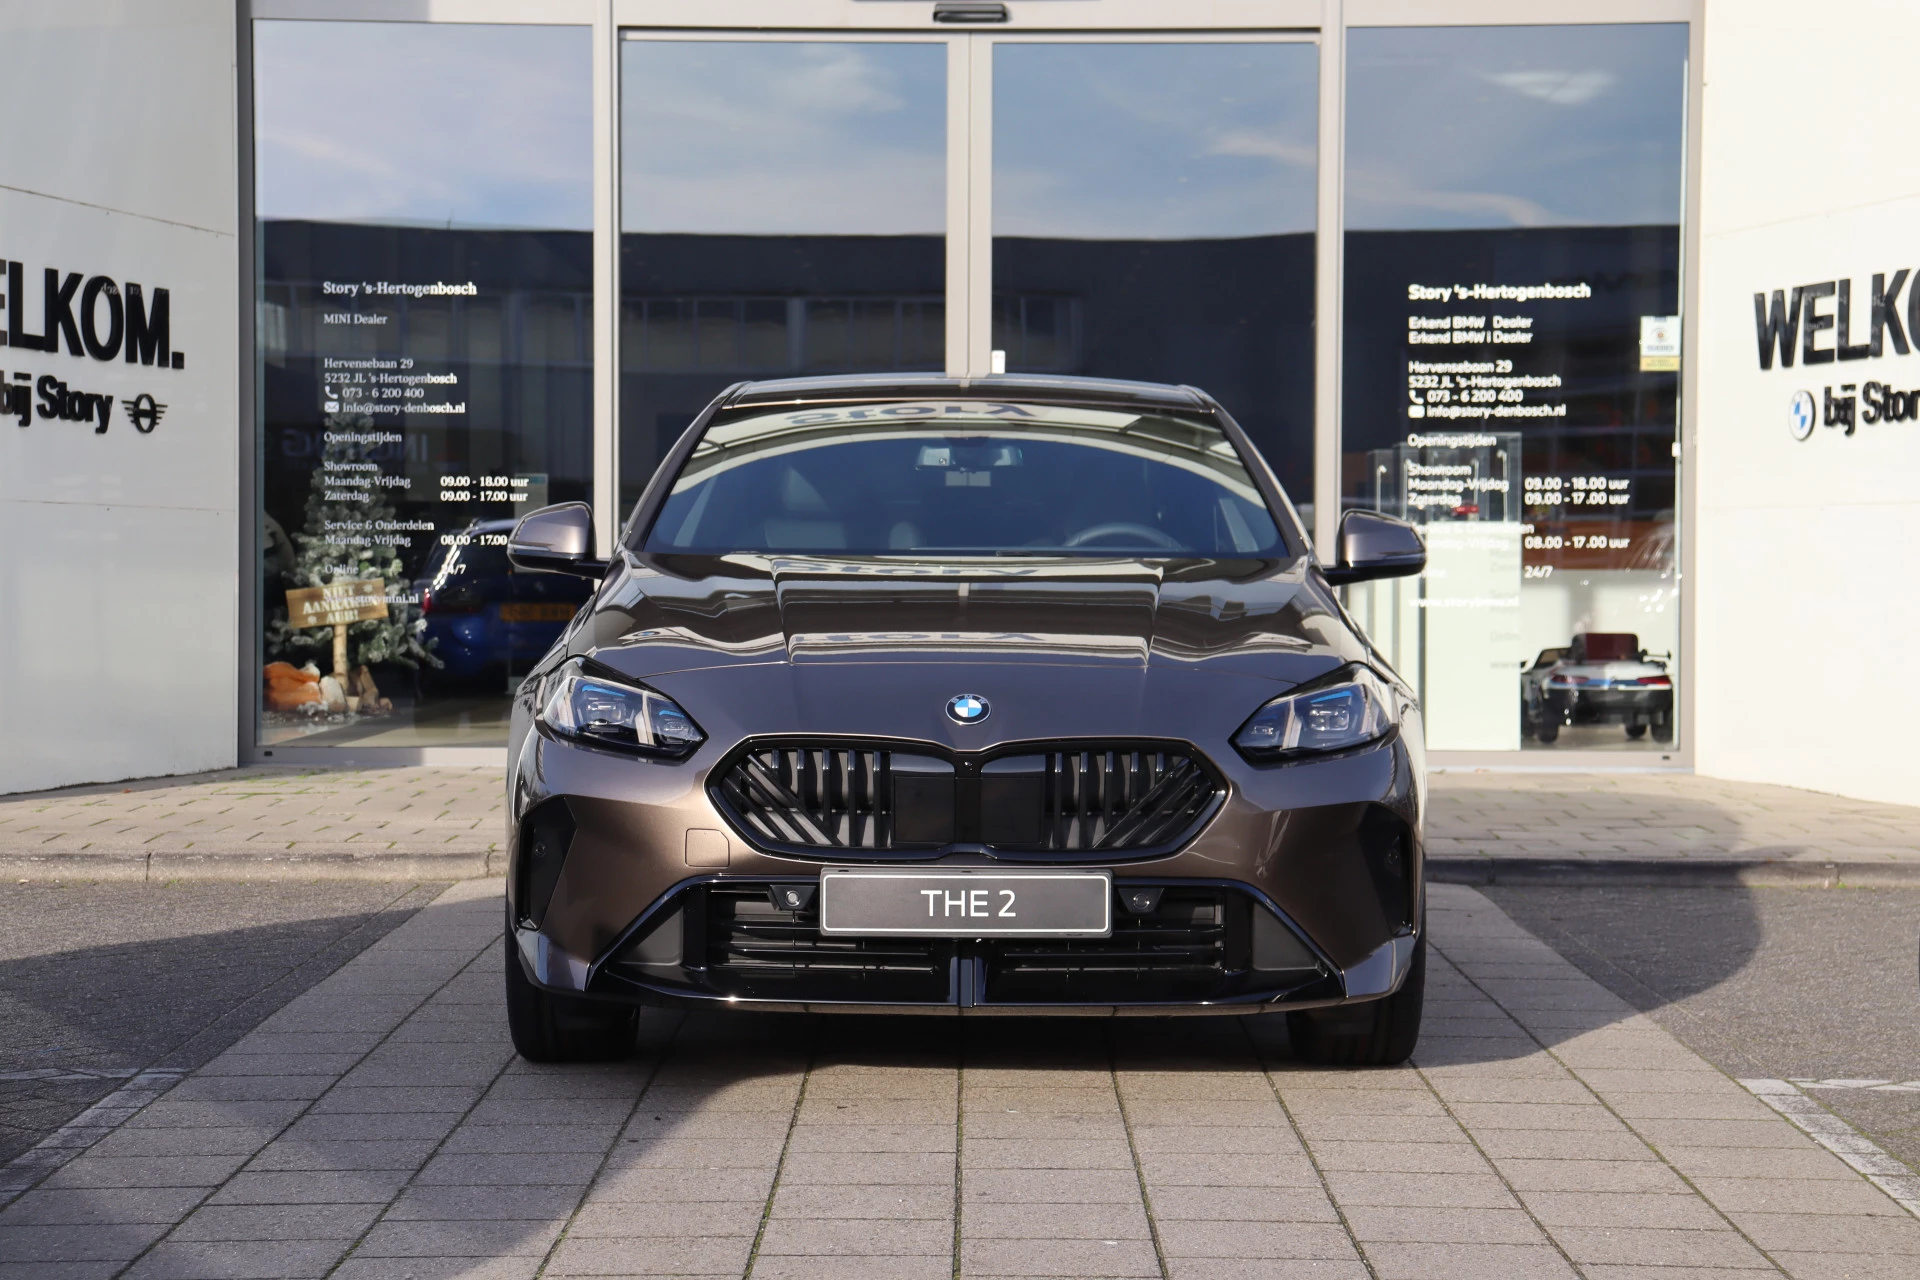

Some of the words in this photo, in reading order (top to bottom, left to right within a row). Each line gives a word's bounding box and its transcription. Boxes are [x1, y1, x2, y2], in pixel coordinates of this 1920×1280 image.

[323, 281, 359, 297] Story
[1408, 284, 1452, 302] Story
[0, 259, 185, 370] LKOM.
[324, 313, 351, 325] MINI
[354, 313, 388, 325] Dealer
[1408, 316, 1450, 330] Erkend
[1452, 316, 1485, 330] BMW
[1493, 315, 1534, 329] Dealer
[1408, 331, 1450, 345] Erkend
[1452, 331, 1485, 344] BMW
[1487, 331, 1492, 344] i
[1493, 330, 1534, 344] Dealer
[324, 358, 397, 370] Hervensebaan
[400, 358, 414, 369] 29
[1408, 361, 1495, 374] Hervensebaan
[1496, 360, 1513, 373] 29
[324, 373, 350, 384] 5232
[353, 373, 366, 385] JL
[1408, 375, 1439, 389] 5232
[1440, 375, 1455, 389] JL
[342, 387, 362, 398] 073
[372, 387, 379, 398] 6
[381, 387, 402, 398] 200
[404, 387, 425, 398] 400
[1427, 390, 1450, 403] 073
[1460, 390, 1470, 402] 6
[1471, 390, 1496, 402] 200
[1497, 389, 1524, 402] 400
[36, 374, 113, 434] Story
[342, 401, 466, 416] info@story-denbosch.nl
[1823, 384, 1856, 437] bij
[1427, 404, 1567, 419] info@story-denbosch.nl
[324, 431, 402, 445] Openingstijden
[1407, 433, 1497, 449] Openingstijden
[324, 461, 378, 472] Showroom
[1408, 463, 1472, 477] Showroom
[324, 475, 412, 489] Maandag-Vrijdag
[440, 476, 471, 488] 09.00
[480, 476, 509, 488] 18.00
[510, 478, 530, 488] uur
[1408, 477, 1509, 493] Maandag-Vrijdag
[1524, 477, 1562, 490] 09.00
[1572, 476, 1607, 490] 18.00
[1608, 479, 1629, 490] uur
[324, 490, 370, 503] Zaterdag
[440, 491, 471, 502] 09.00
[479, 491, 508, 502] 17.00
[509, 493, 528, 502] uur
[1408, 492, 1462, 509] Zaterdag
[1524, 492, 1562, 505] 09.00
[1609, 494, 1630, 504] uur
[324, 520, 362, 531] Service
[365, 520, 373, 530] &
[375, 520, 435, 531] Onderdelen
[324, 534, 411, 548] Maandag-Vrijdag
[440, 535, 471, 546] 08.00
[479, 535, 508, 546] 17.00
[1524, 535, 1562, 549] 08.00
[1609, 537, 1630, 549] uur
[324, 563, 359, 575] Online
[1523, 566, 1554, 578] 24/7
[920, 890, 989, 917] THE
[998, 889, 1017, 917] 2
